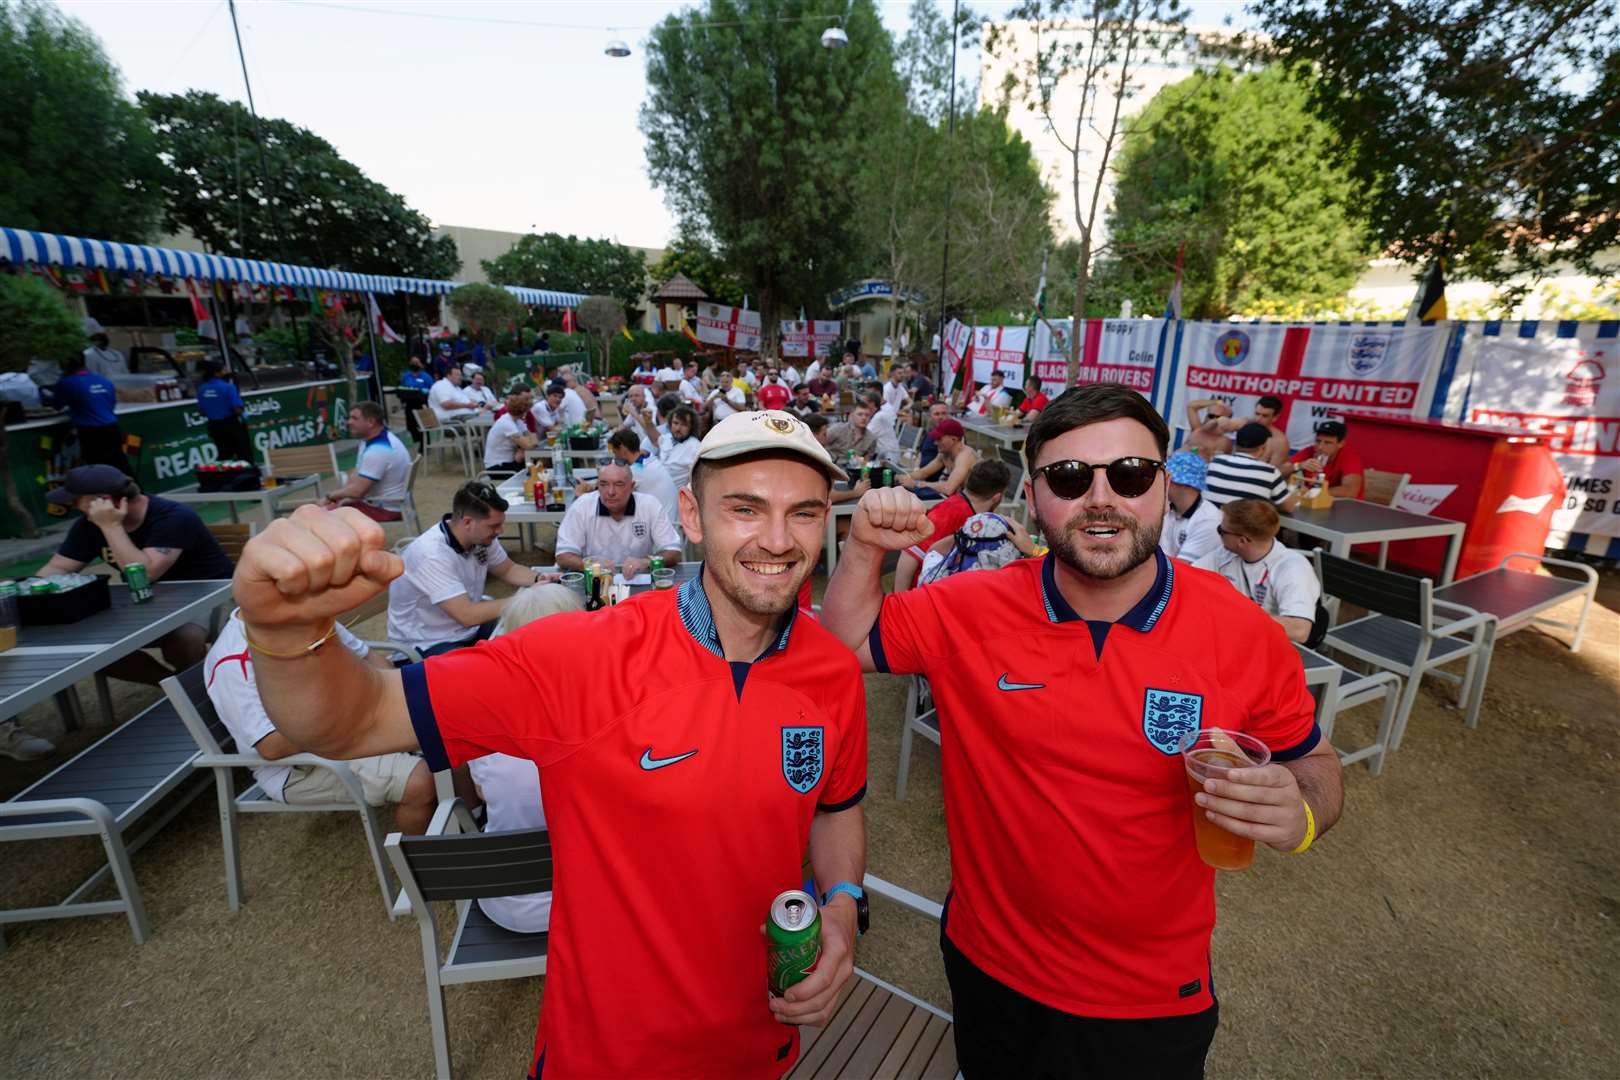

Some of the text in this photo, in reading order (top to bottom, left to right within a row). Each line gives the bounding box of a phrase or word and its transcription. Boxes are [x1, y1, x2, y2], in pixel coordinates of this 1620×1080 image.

[1101, 368, 1151, 388] ROVERS
[1189, 369, 1413, 404] SCUNTHORPE UNITED
[255, 420, 315, 451] GAMES
[1567, 477, 1613, 493] IMES
[1584, 498, 1606, 512] SO
